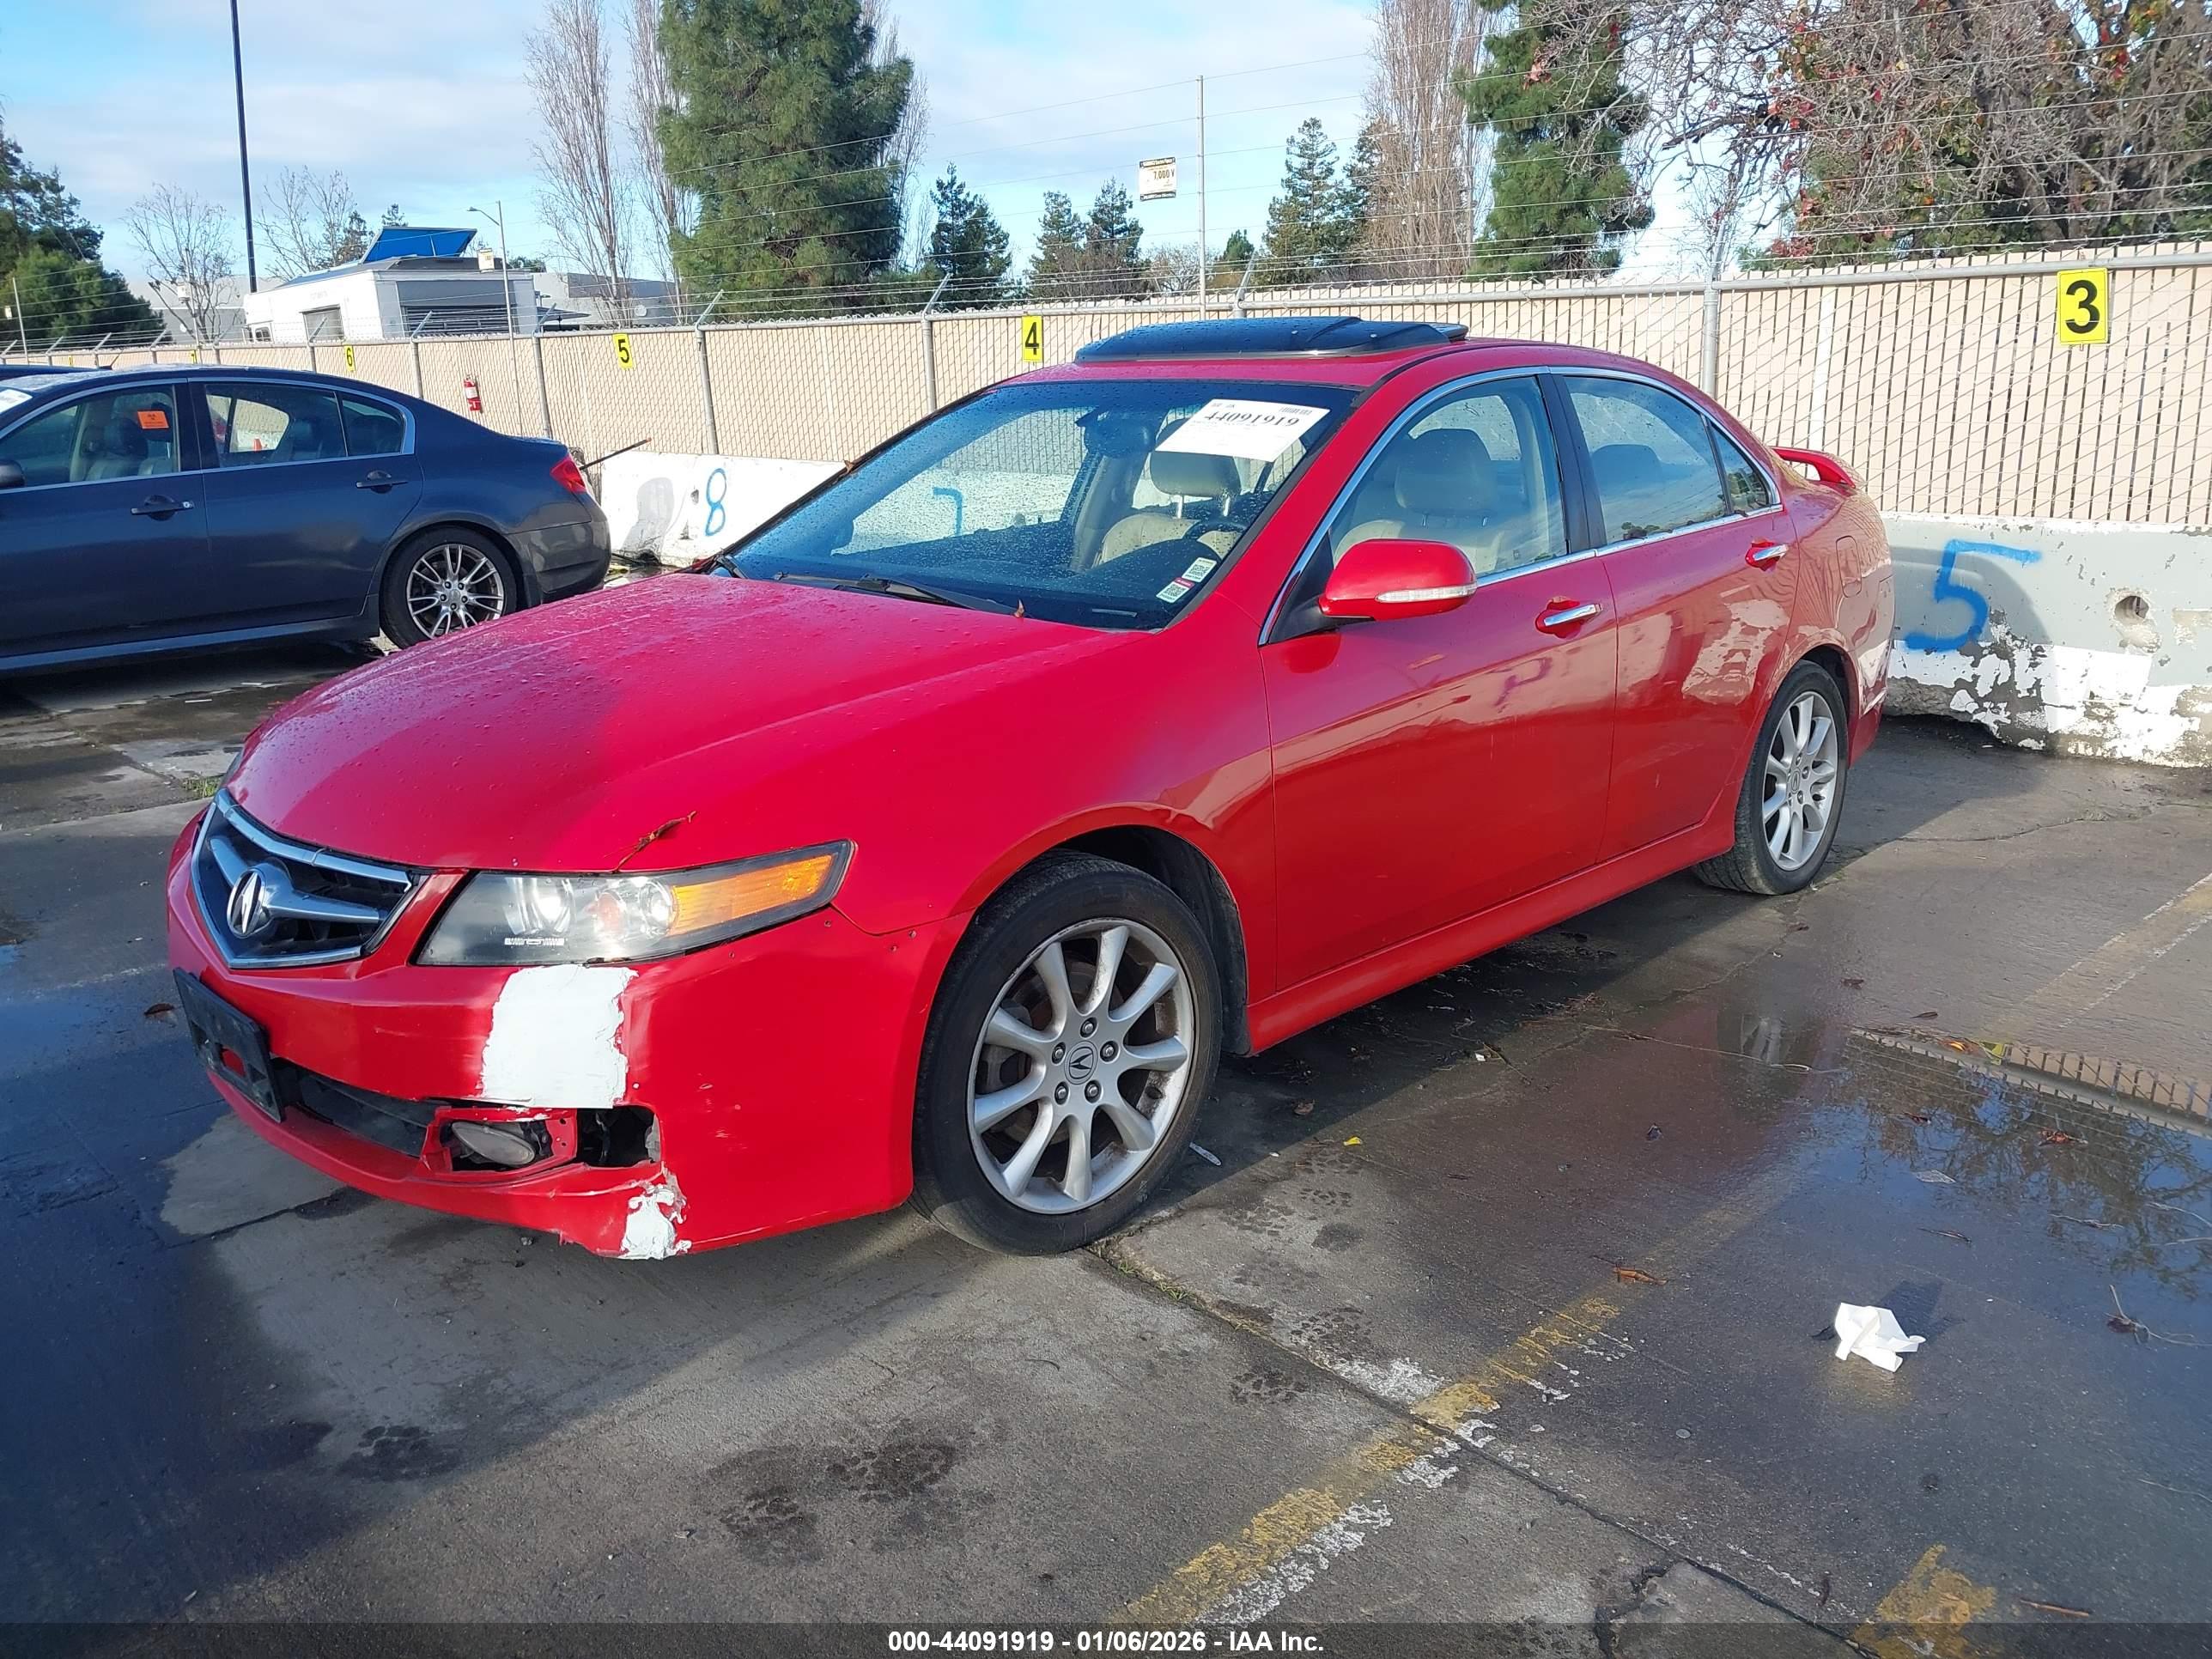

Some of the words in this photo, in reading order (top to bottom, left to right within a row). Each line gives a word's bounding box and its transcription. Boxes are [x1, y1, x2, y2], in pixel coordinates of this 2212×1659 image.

[2065, 279, 2100, 335] 3
[617, 338, 630, 364] 5
[1024, 321, 1040, 356] 4
[346, 347, 353, 368] 6
[1204, 411, 1300, 427] 44091919
[705, 468, 727, 537] 8
[1905, 538, 2042, 652] 5
